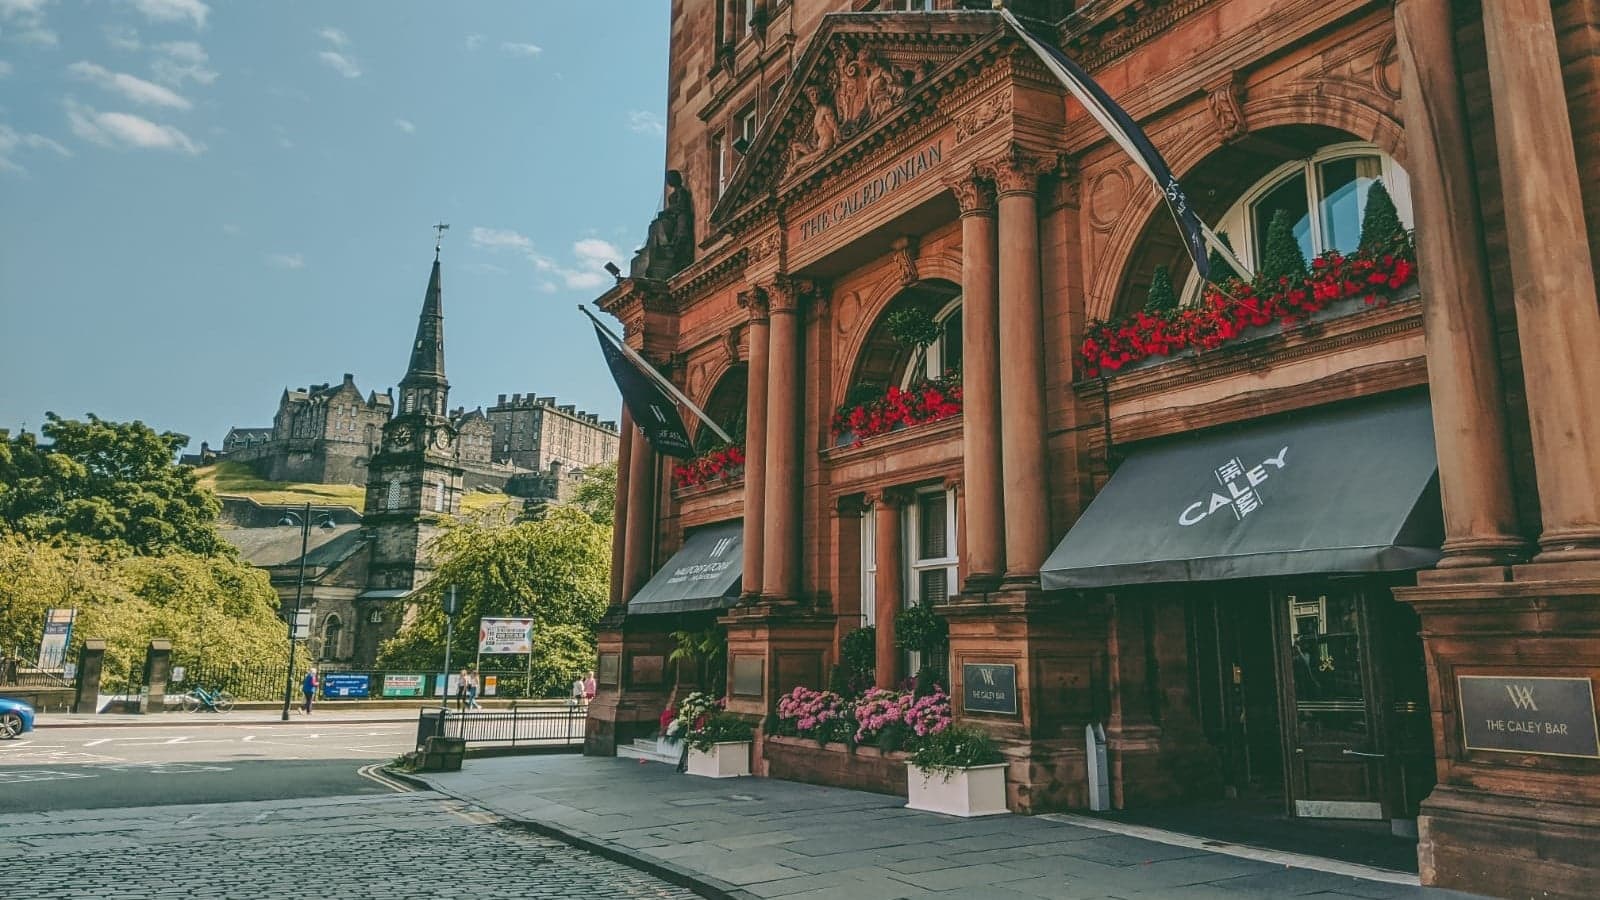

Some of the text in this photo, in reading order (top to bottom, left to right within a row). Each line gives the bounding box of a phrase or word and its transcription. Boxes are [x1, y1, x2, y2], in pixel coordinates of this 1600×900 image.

[800, 139, 944, 241] THE CALEDONIAN
[1218, 459, 1242, 483] THE
[1178, 446, 1289, 526] CALEY
[1235, 491, 1258, 518] BAR
[1486, 719, 1568, 736] THE CALEY BAR
